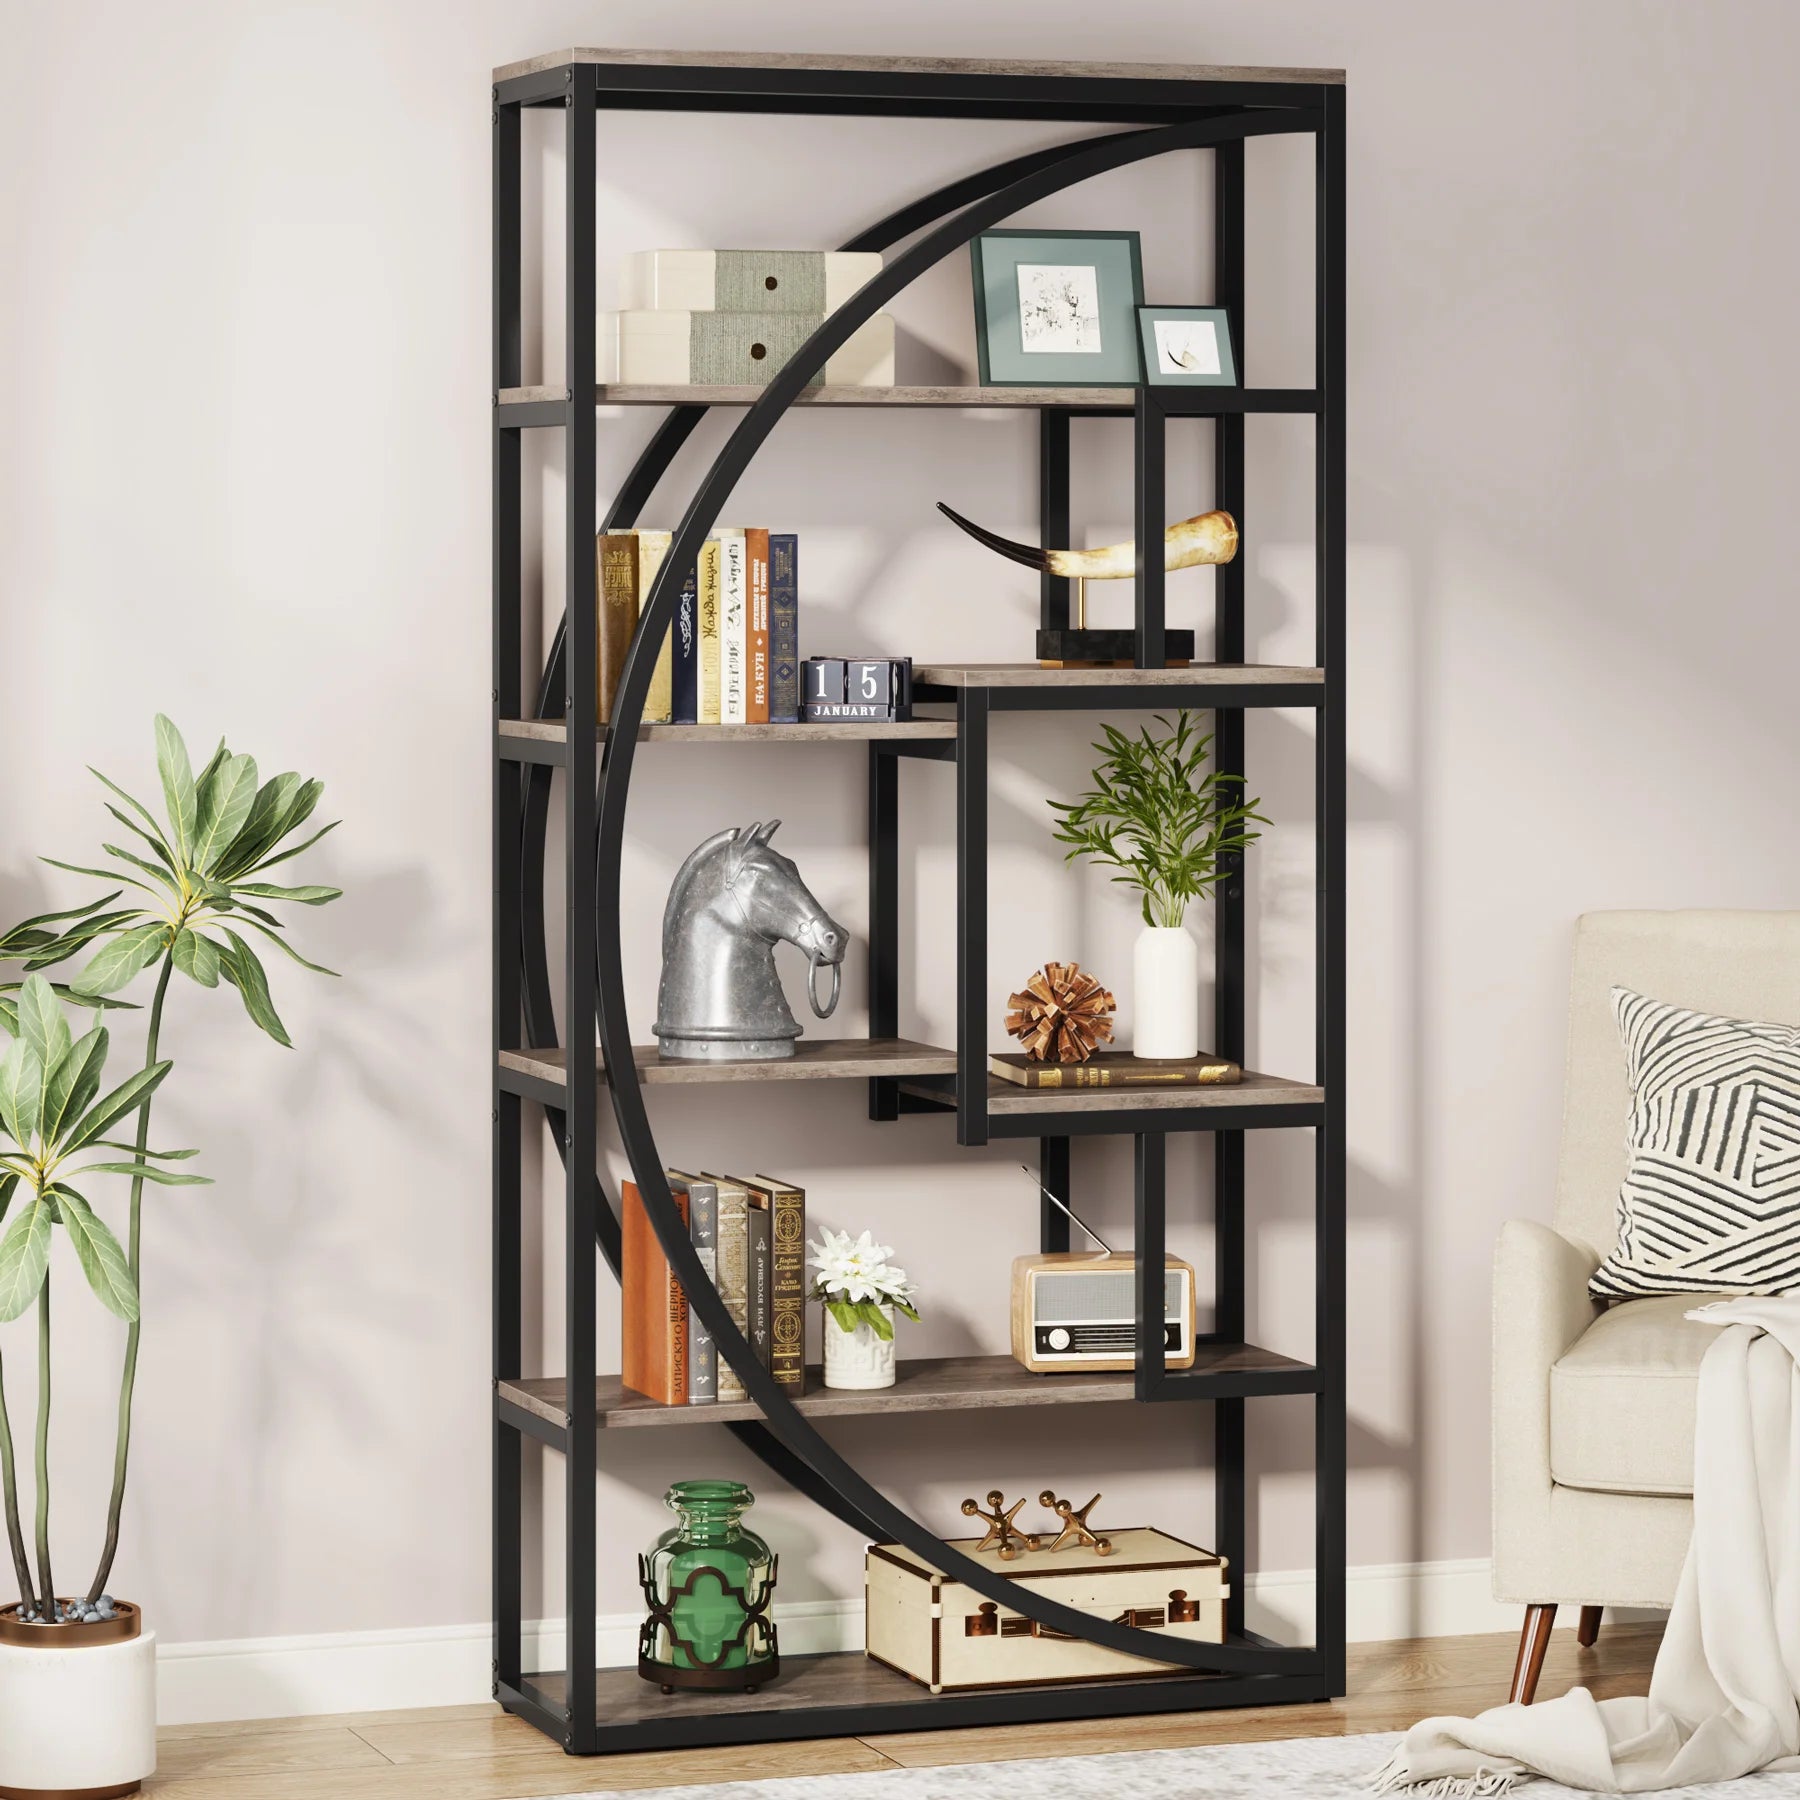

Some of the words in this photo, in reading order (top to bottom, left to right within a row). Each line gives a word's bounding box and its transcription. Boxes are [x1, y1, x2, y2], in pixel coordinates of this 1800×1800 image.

[816, 663, 827, 697] 1
[861, 665, 877, 699] 5
[814, 705, 877, 716] JANUARY
[674, 1337, 682, 1396] ЗАПИСКИ
